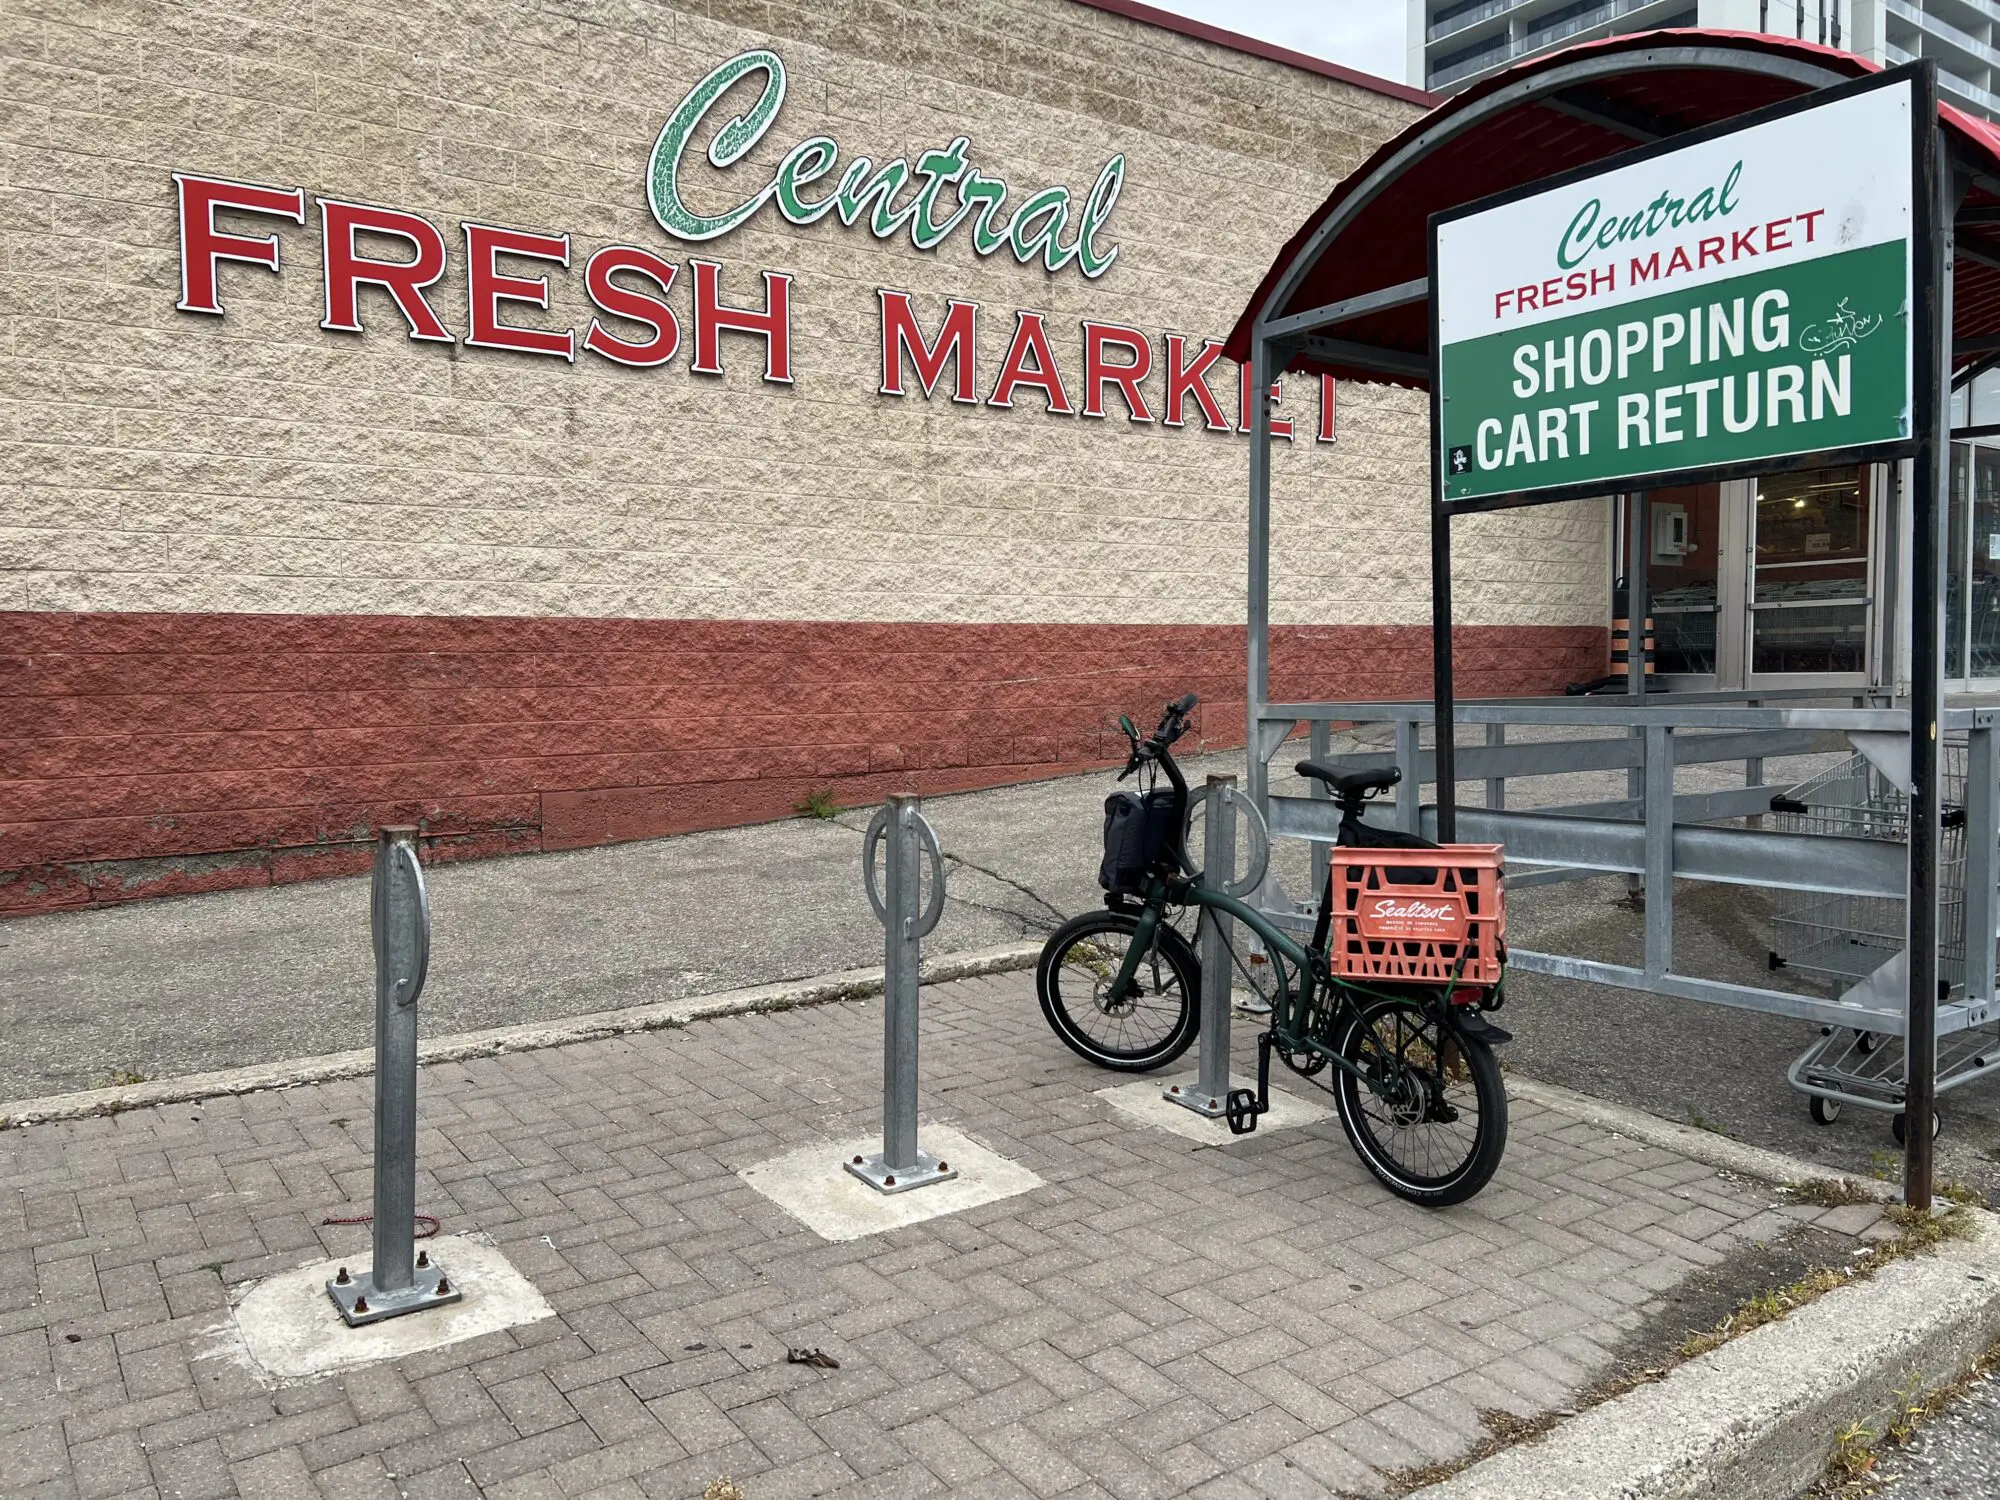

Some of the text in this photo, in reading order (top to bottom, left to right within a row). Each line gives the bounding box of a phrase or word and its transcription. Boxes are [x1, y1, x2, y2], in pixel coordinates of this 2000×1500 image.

[646, 48, 1126, 278] Central
[1556, 160, 1743, 270] Central
[171, 171, 795, 384] FRESH
[1495, 208, 1825, 319] FRESH MARKET
[1512, 289, 1790, 399] SHOPPING
[1476, 354, 1852, 471] CART RETURN
[1370, 900, 1455, 921] Sealtest
